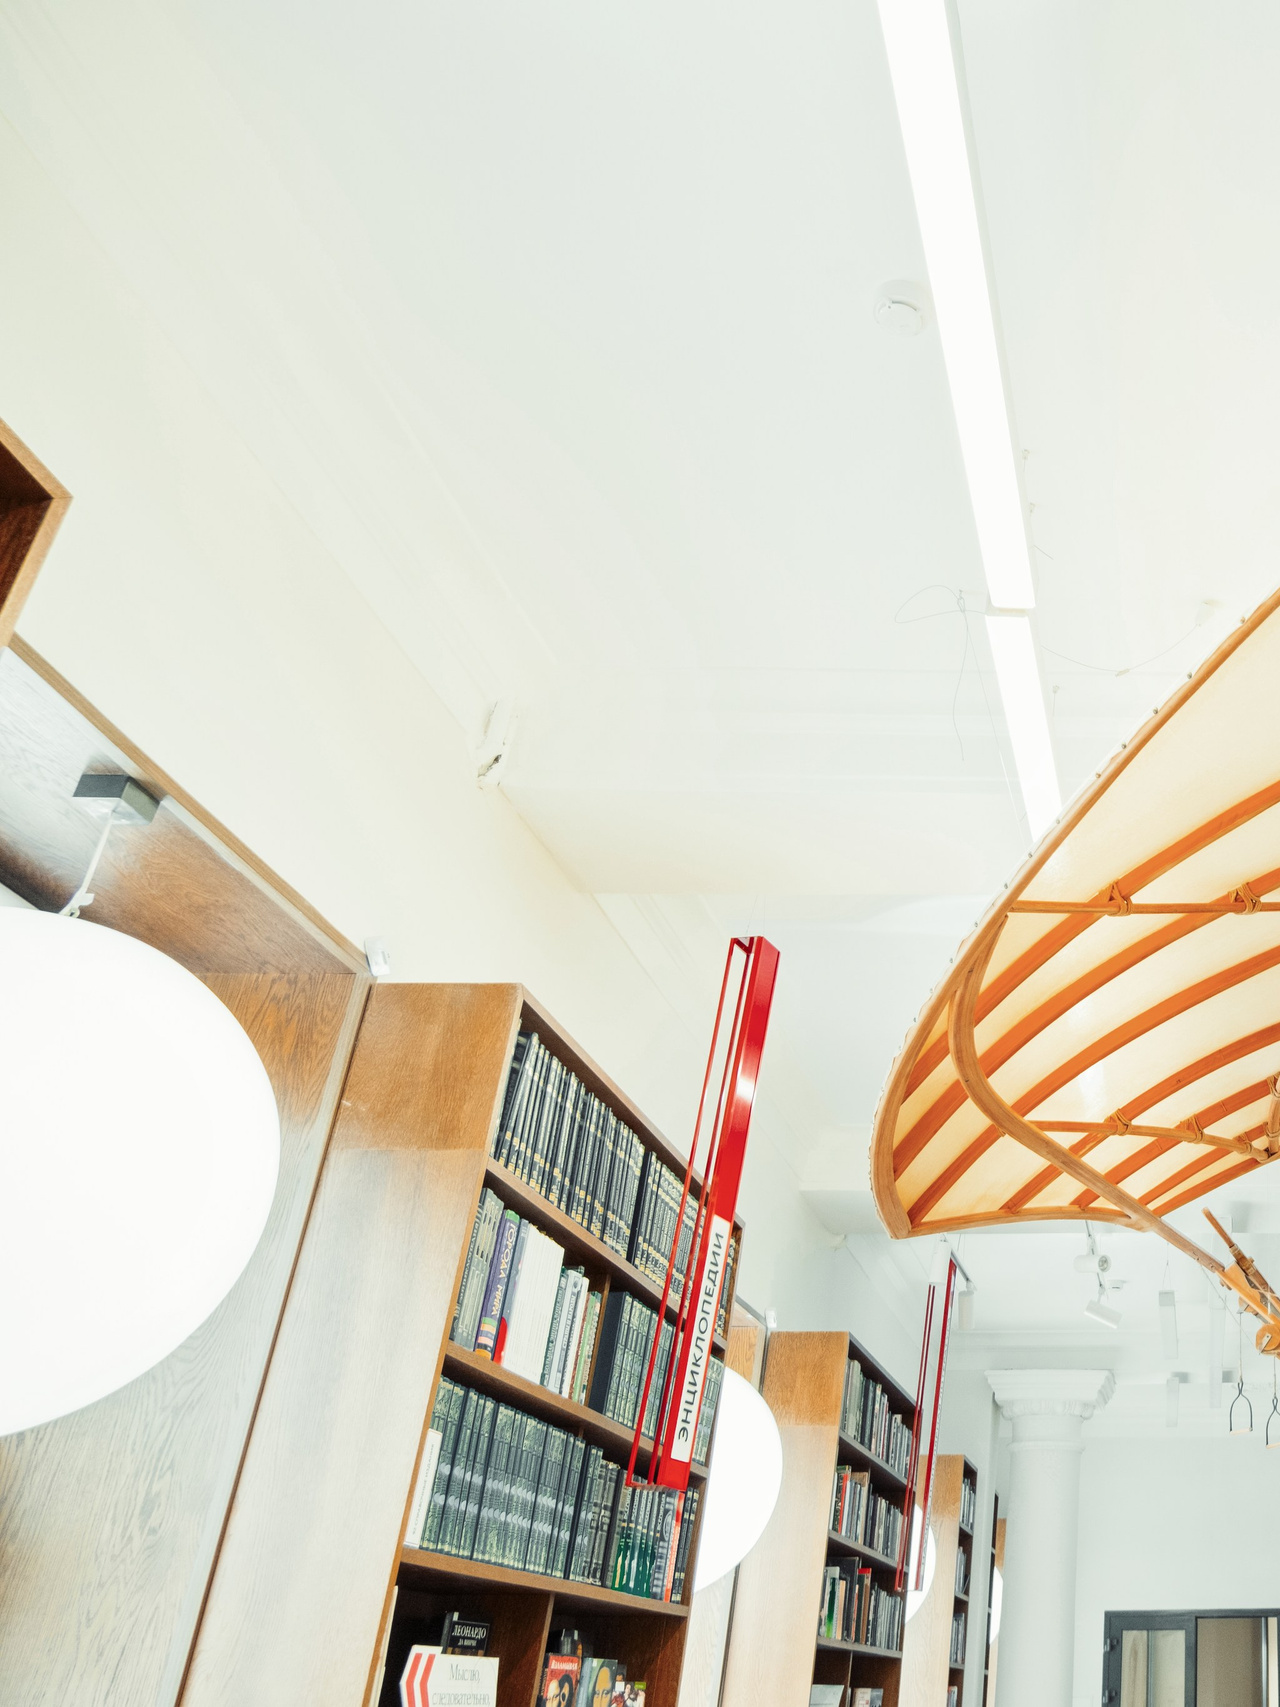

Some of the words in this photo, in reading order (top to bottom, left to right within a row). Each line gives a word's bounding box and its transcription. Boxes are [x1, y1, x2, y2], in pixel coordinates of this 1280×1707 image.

[500, 1223, 516, 1278] ГОРОДА
[491, 1284, 504, 1316] МИРА
[678, 1232, 724, 1443] ЭНЦИКЛОПЕДИИ
[451, 1625, 487, 1639] ЛЕОНАРДО
[450, 1664, 481, 1683] Мыслю,
[431, 1692, 491, 1706] следовательно,
